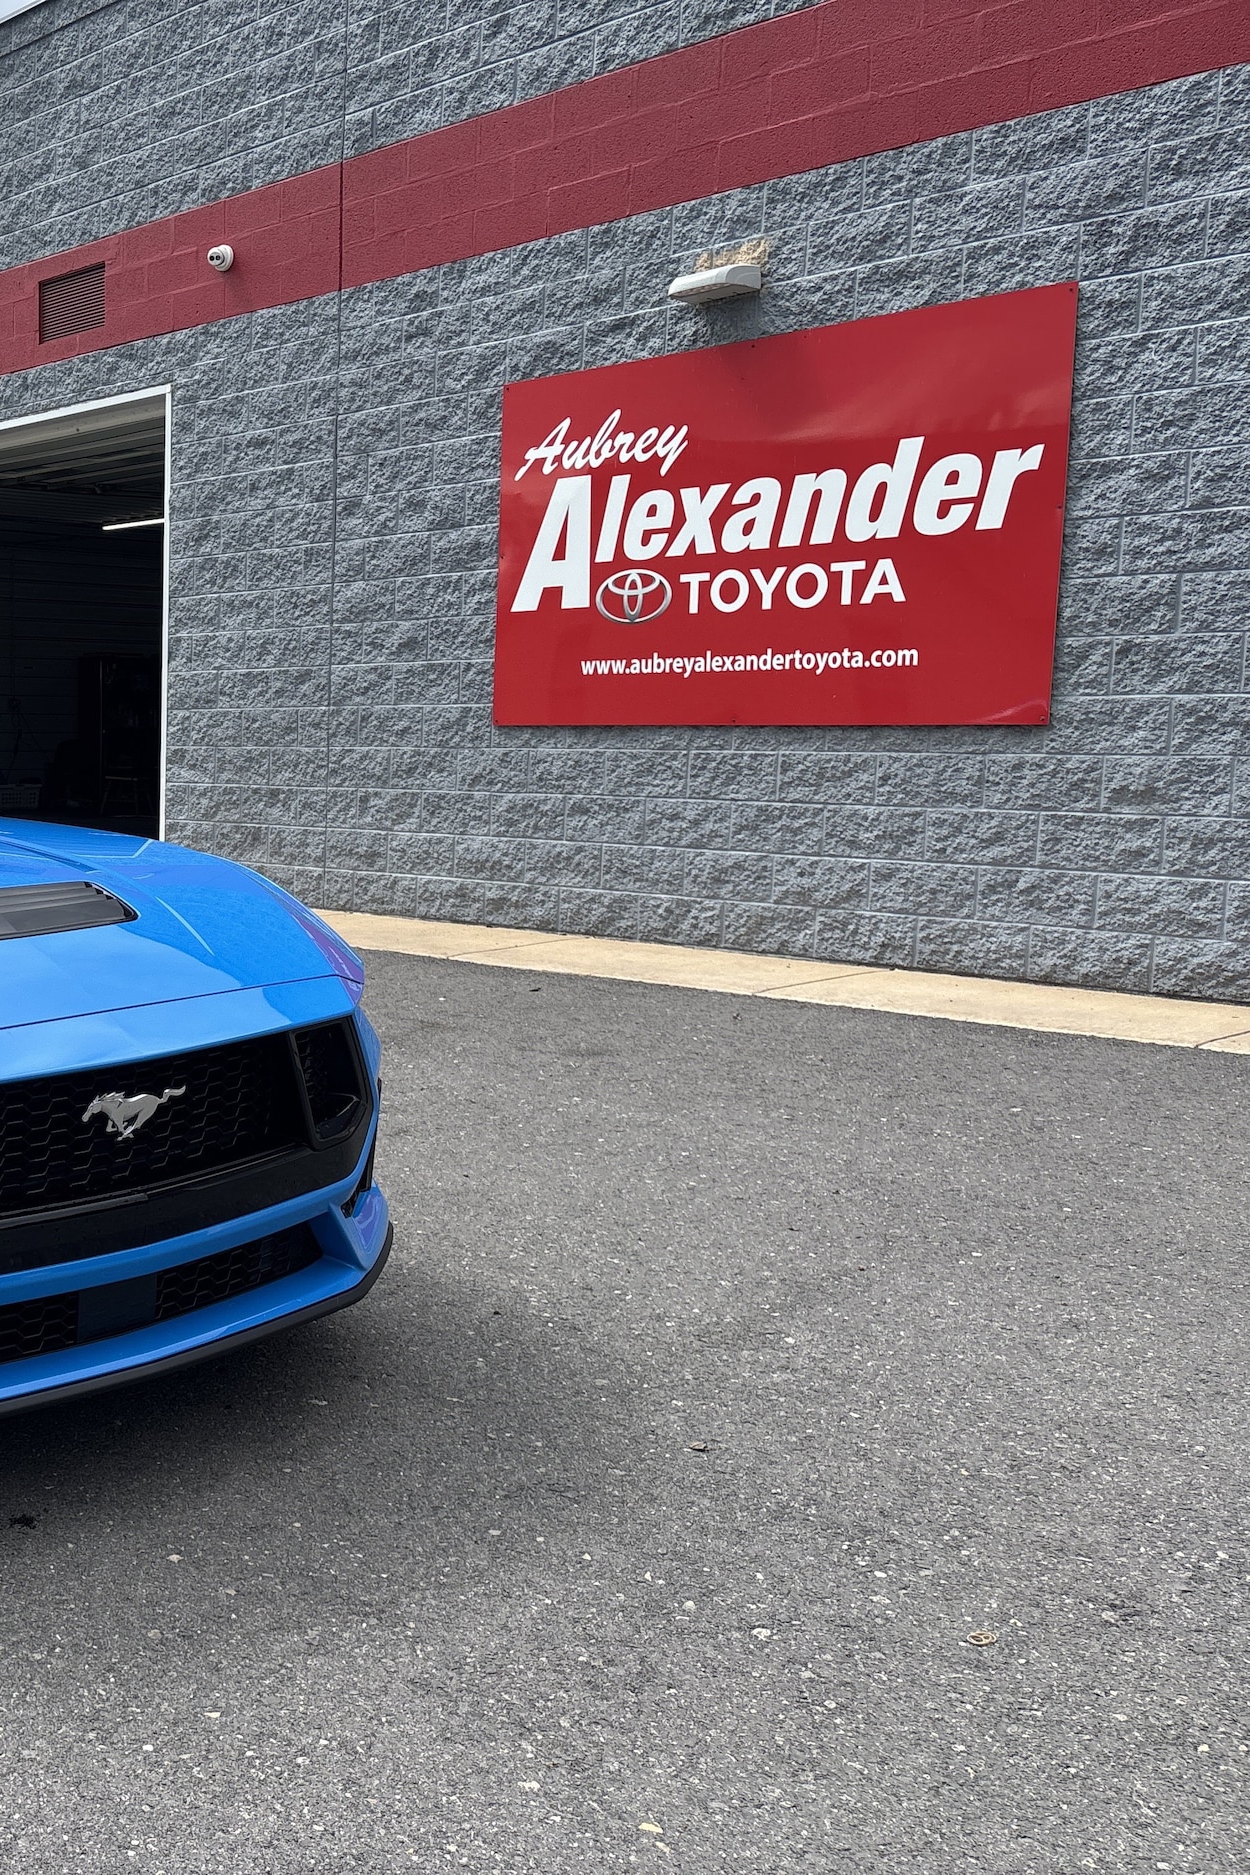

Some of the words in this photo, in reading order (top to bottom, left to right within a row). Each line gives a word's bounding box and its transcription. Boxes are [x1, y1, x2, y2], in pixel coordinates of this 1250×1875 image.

[514, 408, 688, 481] Aubrey
[511, 435, 1044, 613] Alexander
[679, 558, 906, 614] TOYOTA
[580, 647, 919, 679] www.aubreyalexandertoyota.com
